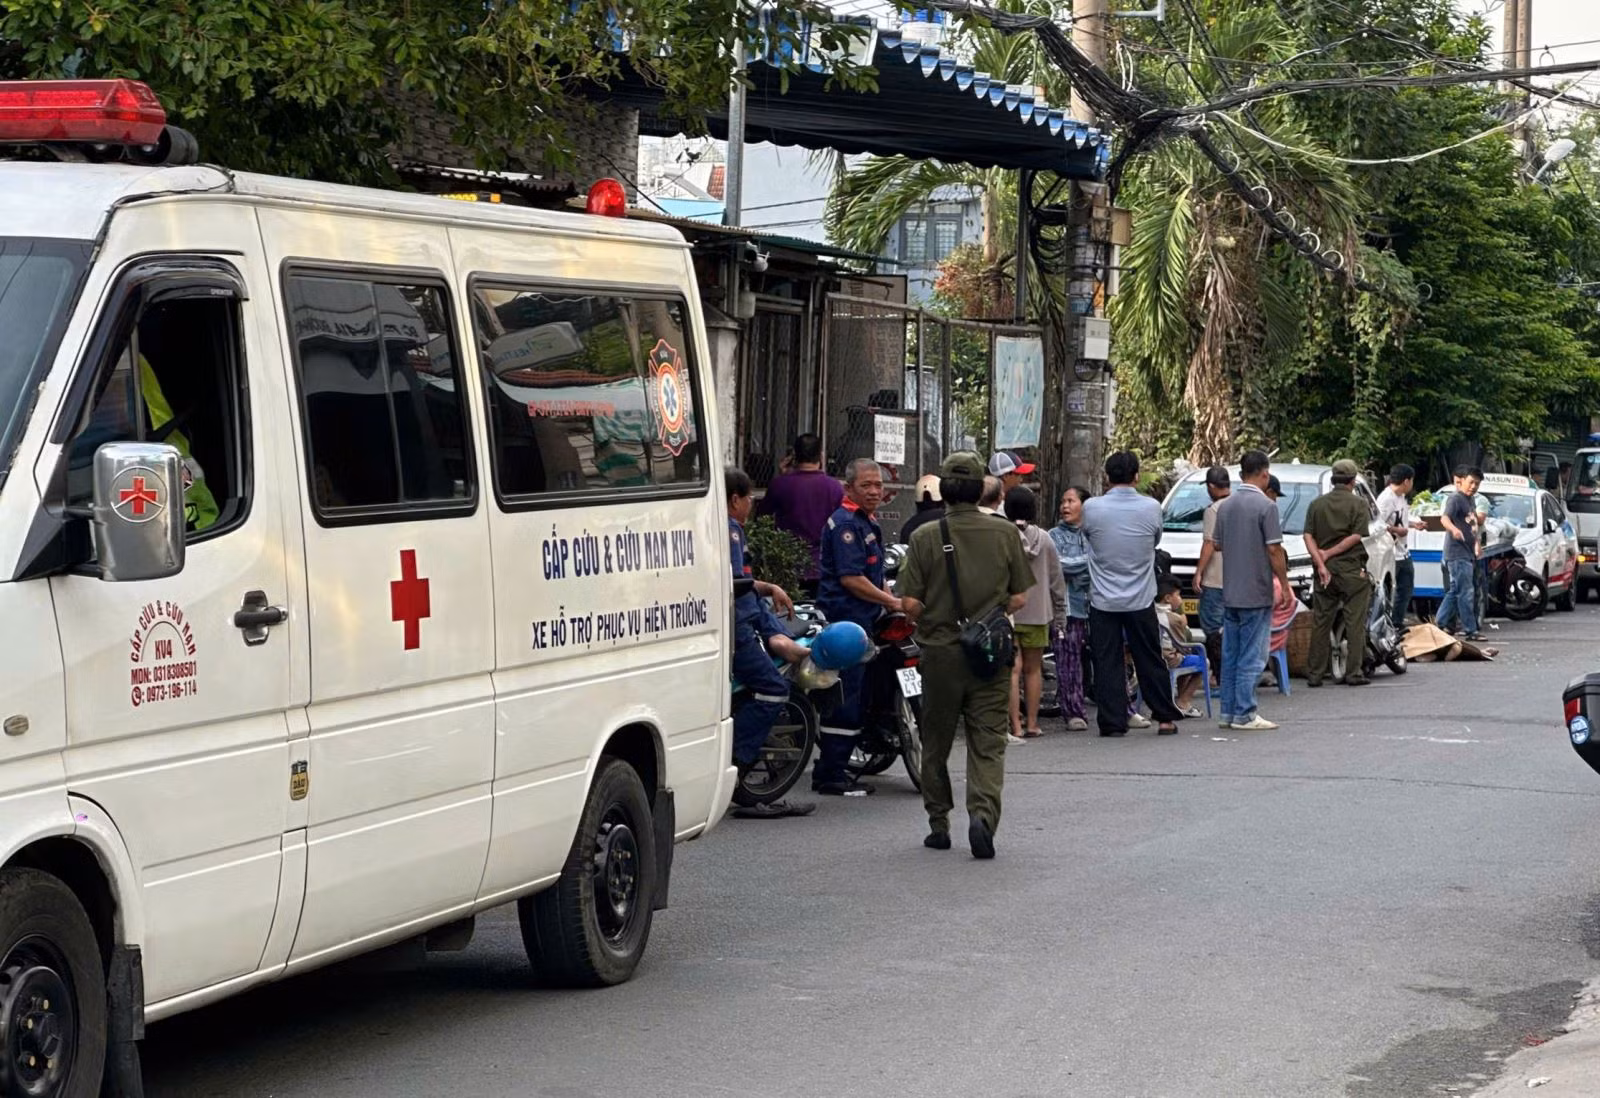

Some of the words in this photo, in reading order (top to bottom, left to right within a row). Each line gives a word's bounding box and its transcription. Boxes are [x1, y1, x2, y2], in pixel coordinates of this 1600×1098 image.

[542, 523, 569, 580] CẤP
[572, 528, 600, 577] CỨU
[604, 535, 613, 574] &
[615, 525, 641, 573] CỨU
[643, 531, 669, 578] NẠN
[671, 530, 695, 568] KV4
[138, 603, 156, 631] CỨU
[165, 600, 184, 626] CỨU
[1183, 601, 1199, 612] 50
[532, 621, 548, 649] XE
[551, 605, 567, 647] HỖ
[570, 612, 593, 649] TRỢ
[597, 611, 626, 645] PHỤC
[628, 609, 641, 641] VỤ
[644, 601, 667, 638] HIỆN
[669, 592, 708, 630] TRƯỜNG
[154, 639, 172, 661] KV4
[130, 667, 152, 686] MDN:
[146, 679, 197, 703] 0973-196-114
